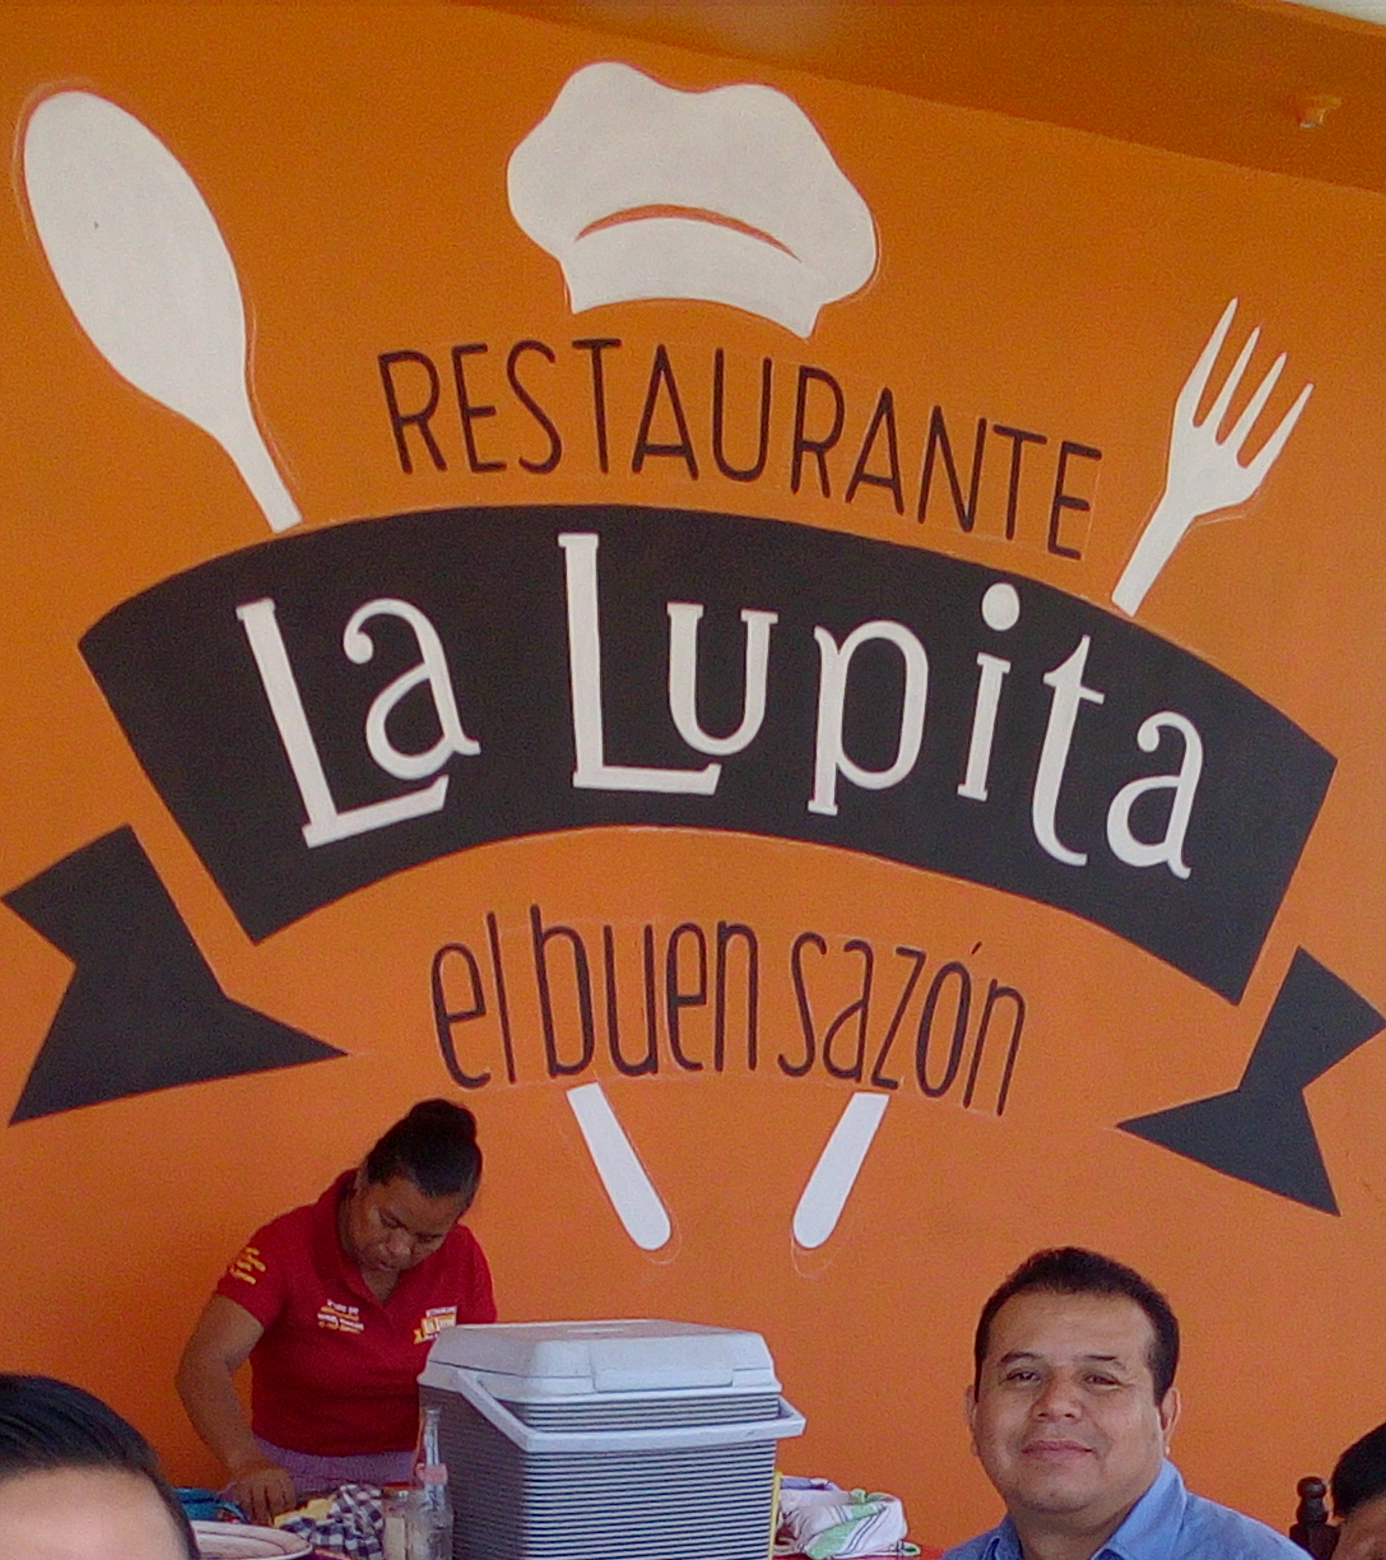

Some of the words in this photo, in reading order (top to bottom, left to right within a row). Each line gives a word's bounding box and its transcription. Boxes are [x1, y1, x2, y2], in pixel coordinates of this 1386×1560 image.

[379, 337, 1103, 561] RESTAURANTE
[234, 597, 482, 849] La
[556, 531, 1207, 880] Lupita
[429, 910, 511, 1090] el
[529, 904, 765, 1080] buen
[775, 929, 1029, 1118] sazón
